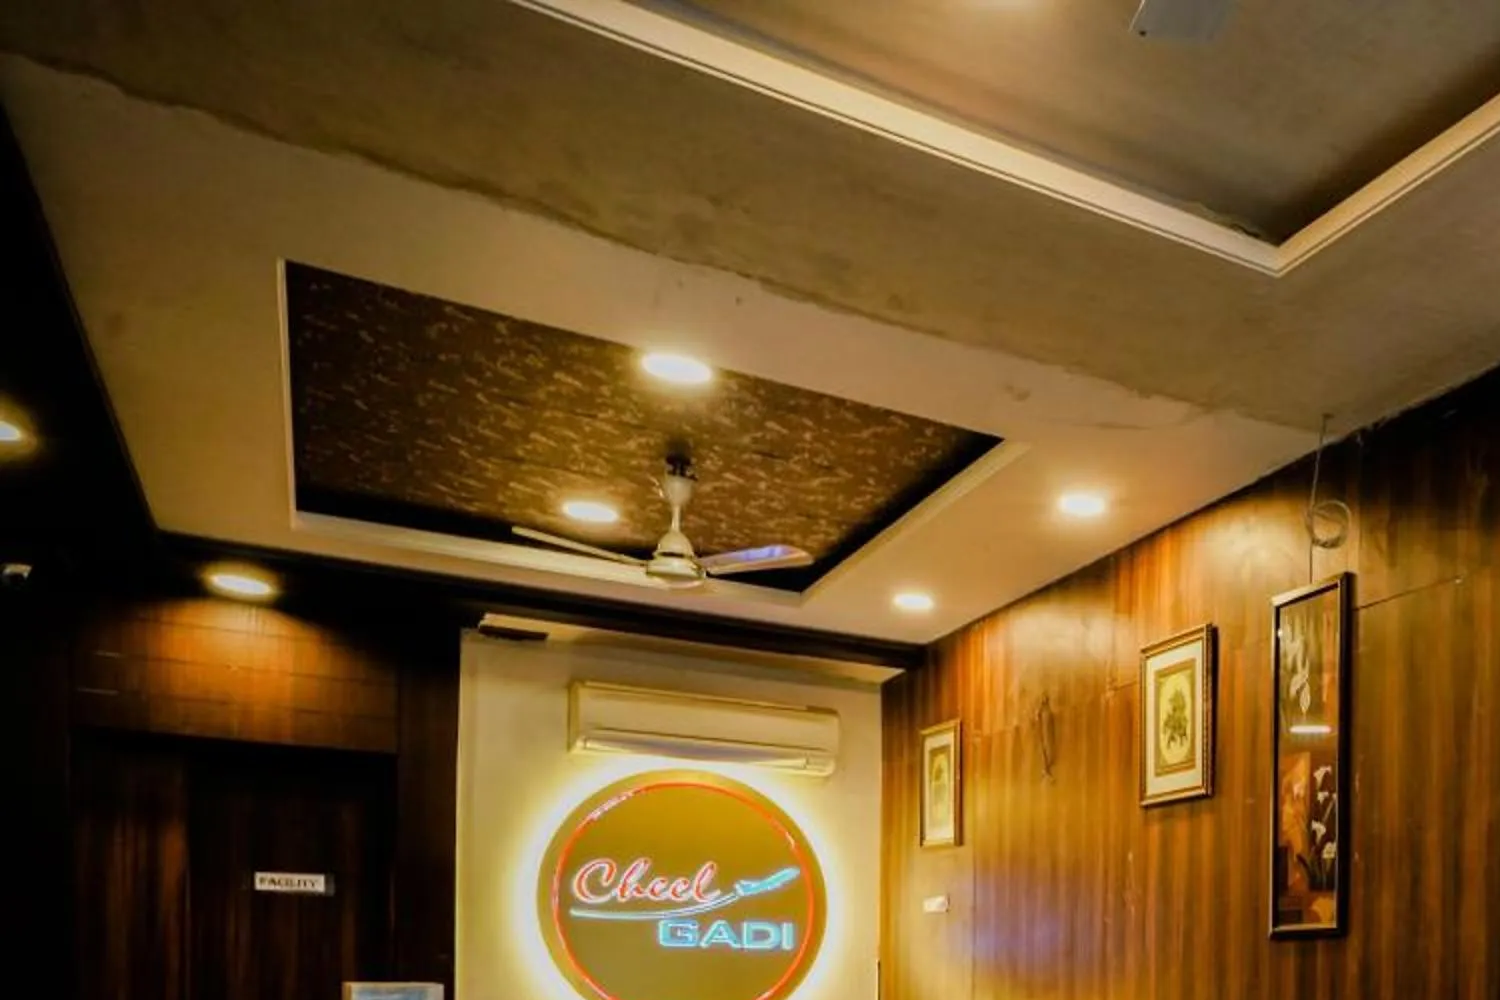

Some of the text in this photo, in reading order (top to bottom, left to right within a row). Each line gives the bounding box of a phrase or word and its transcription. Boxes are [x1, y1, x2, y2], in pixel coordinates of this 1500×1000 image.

[258, 876, 318, 888] FACILITY
[572, 857, 720, 903] Cheel
[657, 919, 795, 950] GADI
